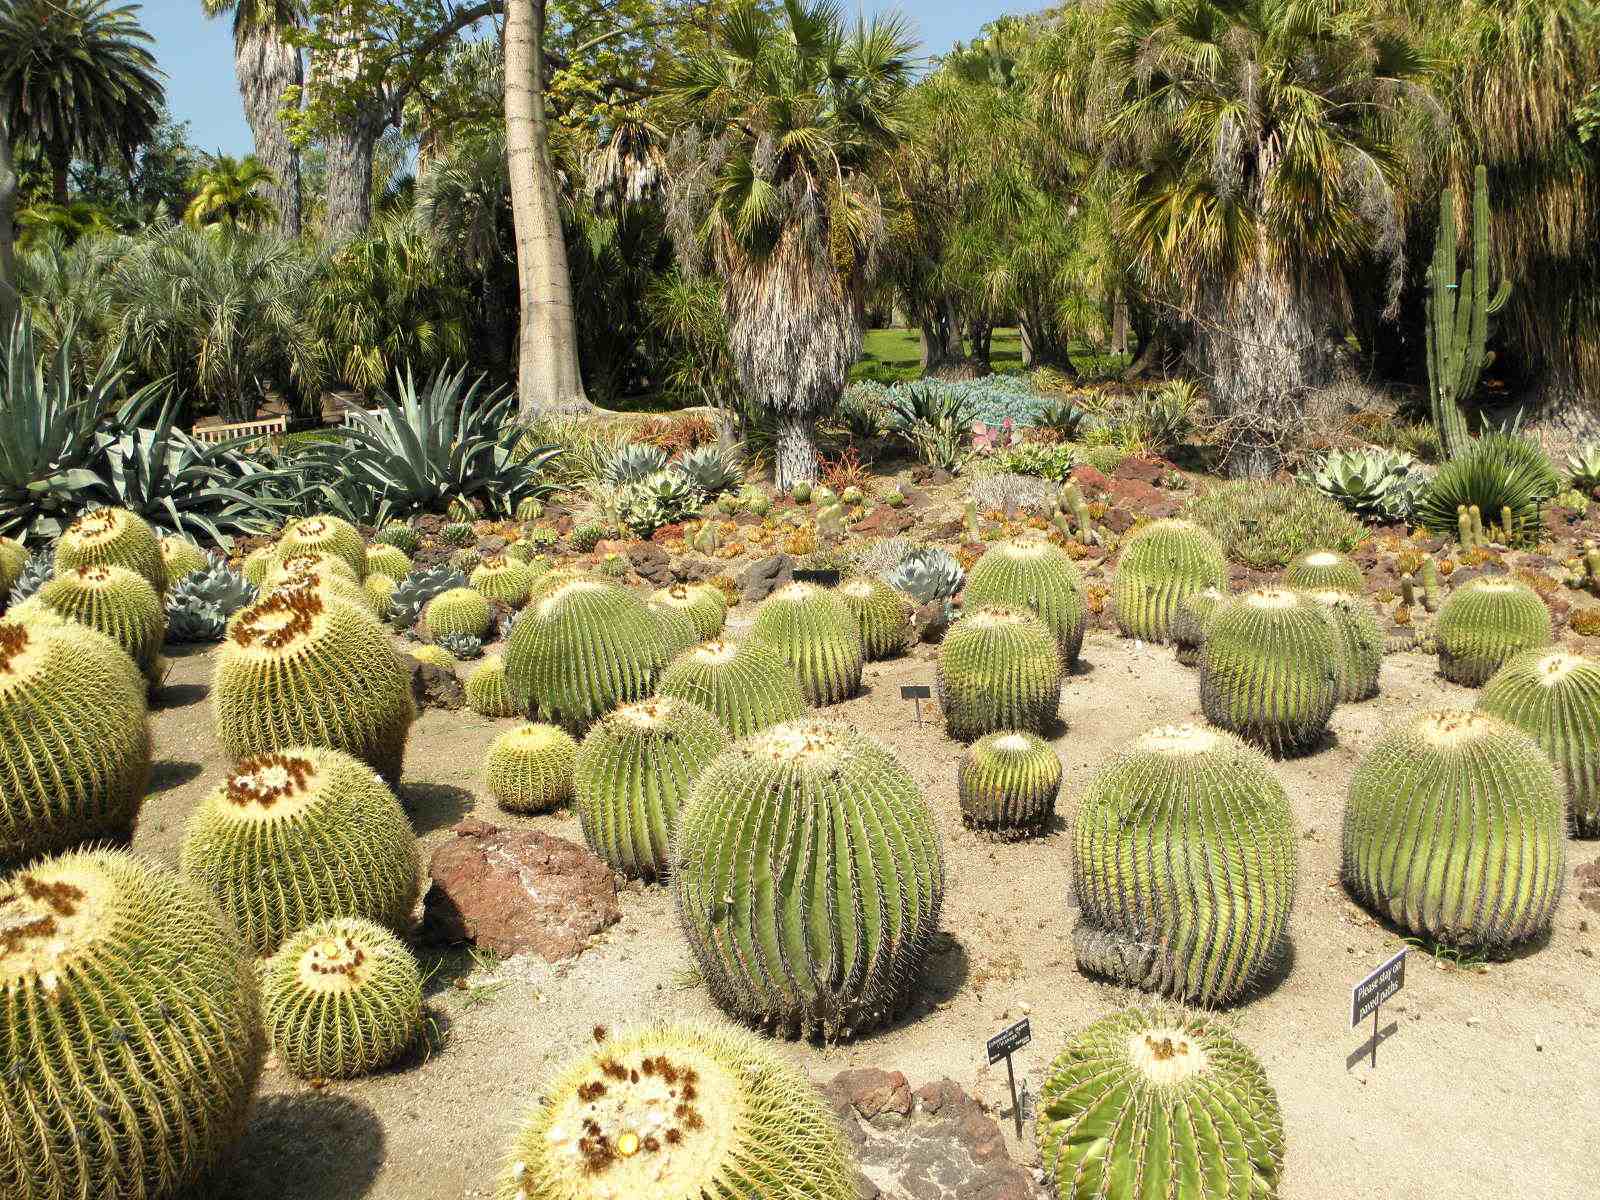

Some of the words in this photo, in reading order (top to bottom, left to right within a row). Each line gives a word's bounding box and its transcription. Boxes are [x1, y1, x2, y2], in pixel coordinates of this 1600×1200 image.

[1358, 980, 1378, 1001] Please
[1380, 968, 1392, 985] stay
[1393, 961, 1401, 974] on
[1360, 992, 1379, 1018] paved
[1381, 981, 1399, 1004] paths
